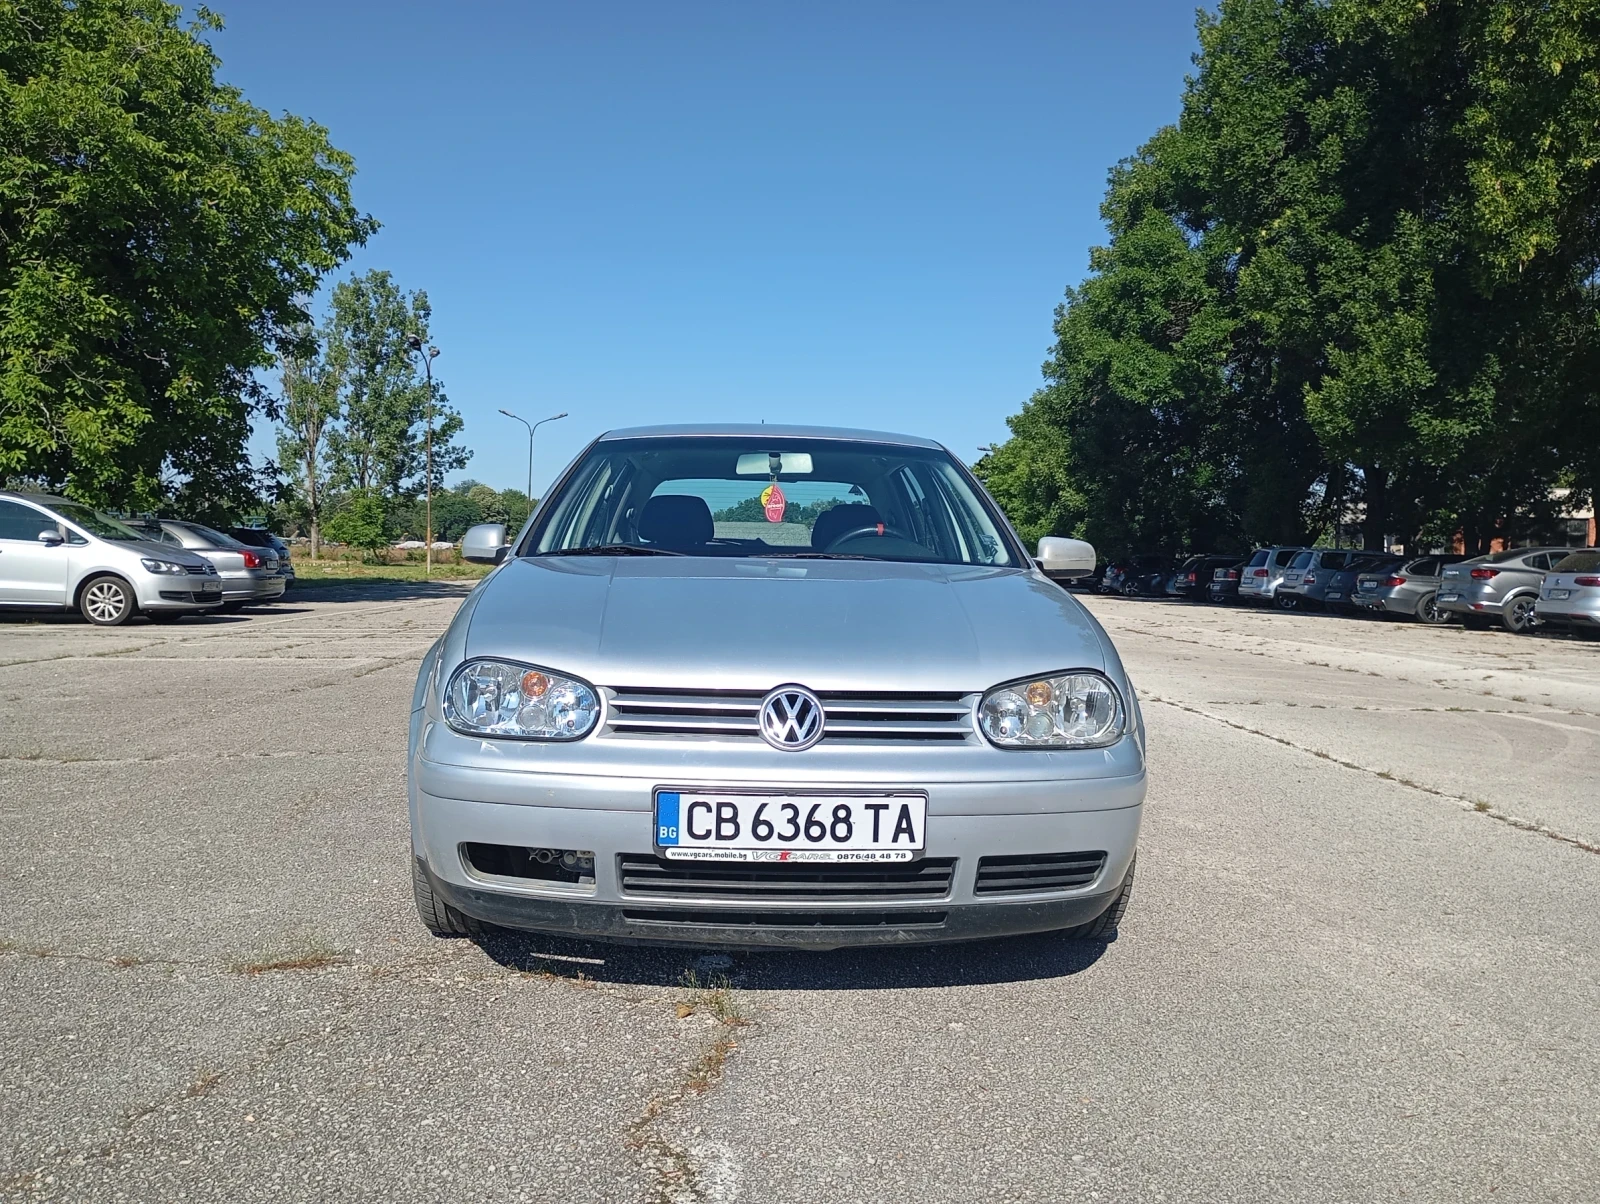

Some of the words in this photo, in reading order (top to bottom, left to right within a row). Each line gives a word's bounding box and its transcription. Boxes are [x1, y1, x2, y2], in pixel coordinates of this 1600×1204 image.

[687, 801, 741, 840] CB
[751, 803, 853, 843] 6368
[864, 804, 916, 843] TA
[659, 827, 677, 839] BG
[671, 851, 747, 860] www.vgcars.mobile.bg
[894, 852, 907, 860] 78
